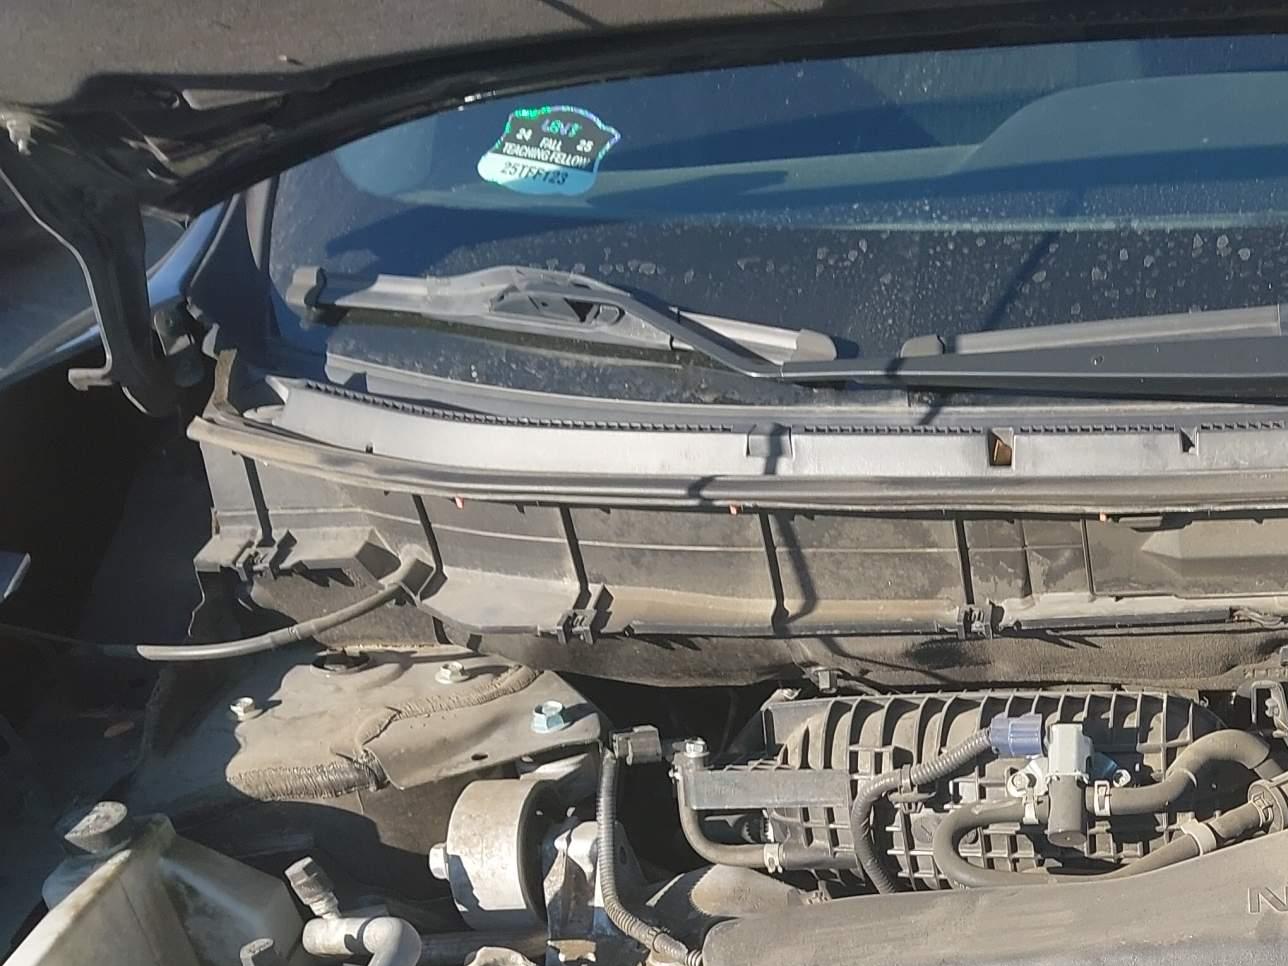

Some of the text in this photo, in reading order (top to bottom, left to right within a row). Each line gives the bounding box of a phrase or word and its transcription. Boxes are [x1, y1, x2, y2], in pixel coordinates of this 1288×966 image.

[502, 142, 592, 169] TEACHING FELLOW
[539, 137, 563, 152] FALL
[576, 139, 594, 153] 25
